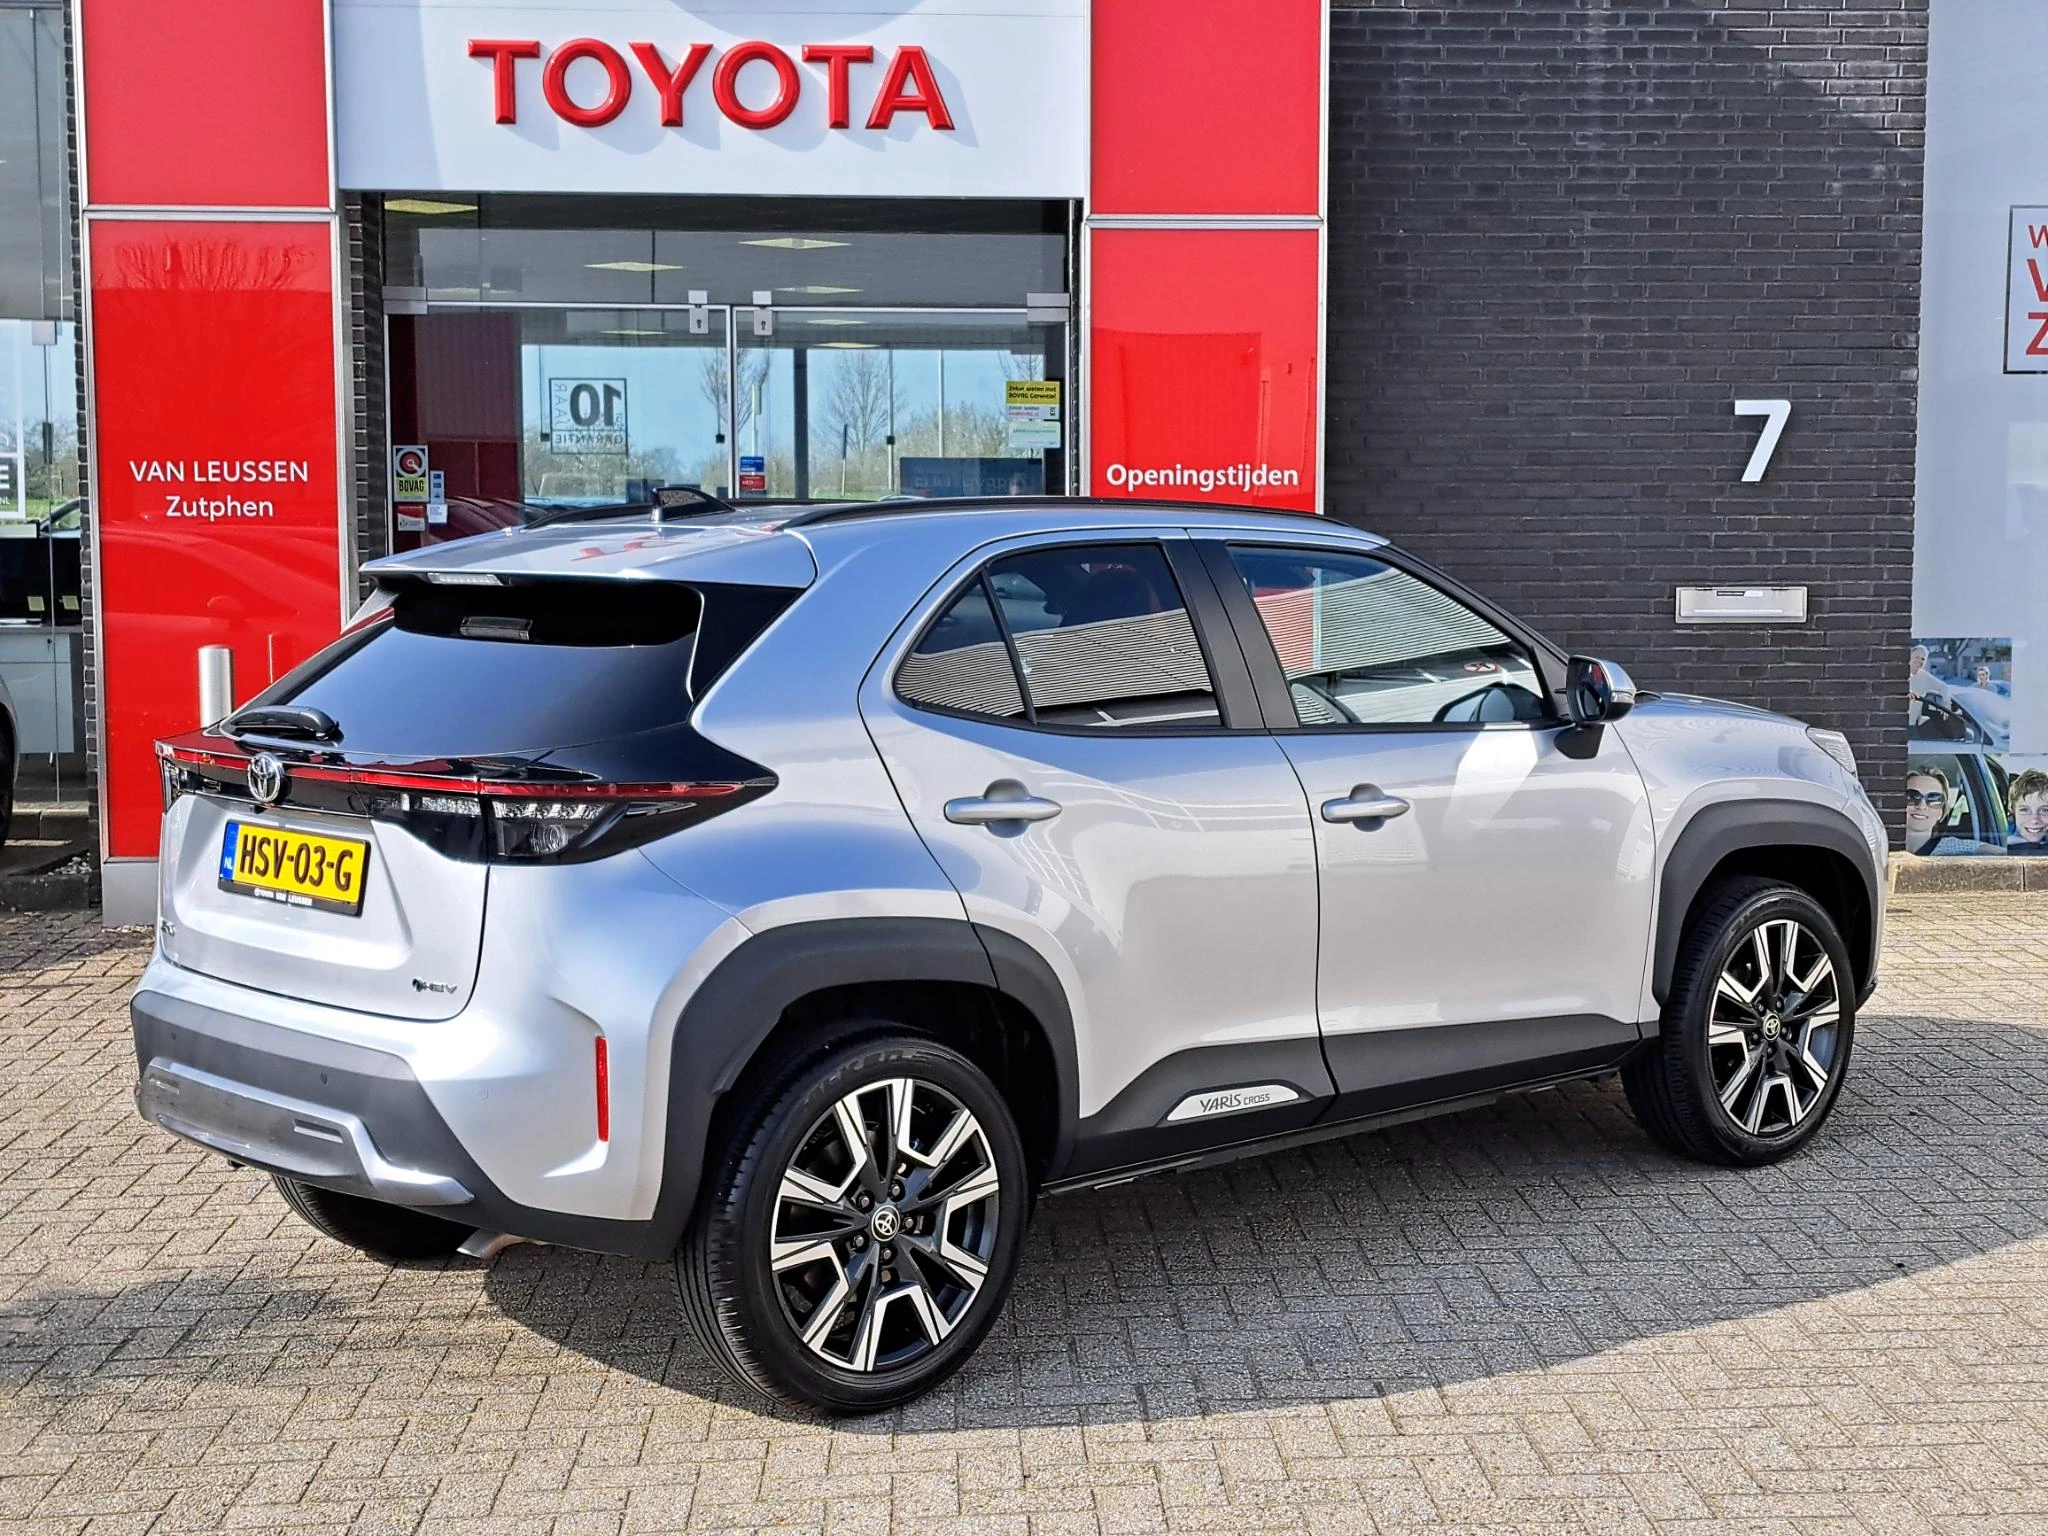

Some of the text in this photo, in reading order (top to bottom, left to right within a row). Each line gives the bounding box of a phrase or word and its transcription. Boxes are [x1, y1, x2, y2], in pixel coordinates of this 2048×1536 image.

[468, 38, 956, 131] TOYOTA
[1734, 400, 1791, 482] 7
[129, 460, 309, 482] VAN LEUSSEN
[1106, 463, 1299, 492] Openingstijden
[399, 480, 425, 493] BOVAG
[165, 494, 274, 522] Zutphen
[223, 856, 233, 870] NL
[239, 833, 354, 892] HSV-03-G
[1200, 1093, 1271, 1113] YARIS CROSS
